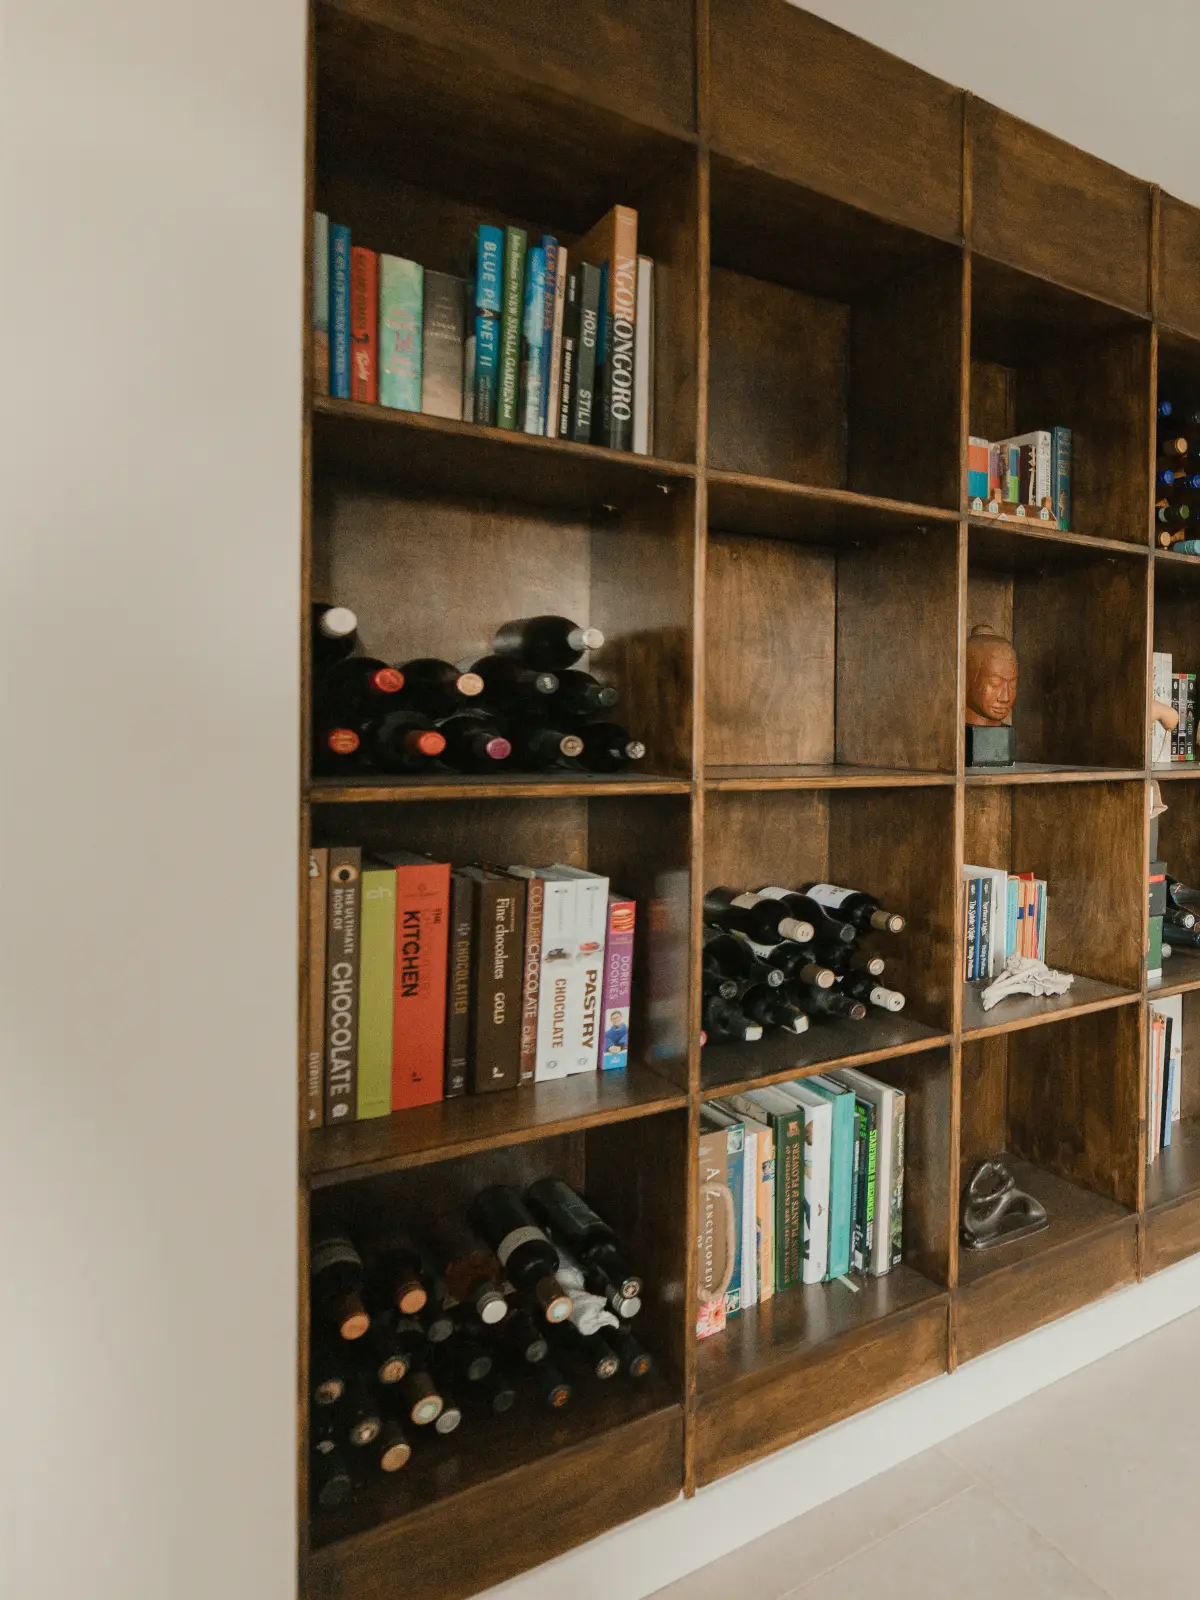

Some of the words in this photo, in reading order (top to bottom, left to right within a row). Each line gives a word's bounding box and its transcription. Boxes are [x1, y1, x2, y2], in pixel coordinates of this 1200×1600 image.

[483, 240, 498, 282] BLUE
[478, 288, 495, 352] PLANET
[506, 292, 518, 317] NEW
[504, 316, 518, 357] SMALL
[565, 338, 573, 351] THE
[582, 309, 597, 347] HOLD
[610, 254, 635, 421] NGORONGORO
[479, 355, 493, 367] II
[502, 357, 517, 404] GARDEN
[563, 351, 572, 382] COMPLETE
[562, 383, 570, 404] GUIDE
[577, 388, 592, 428] STILL
[333, 887, 344, 916] BOOK
[344, 887, 355, 906] THE
[496, 897, 511, 922] Fine
[530, 886, 542, 945] COUTURE
[332, 917, 342, 931] OF
[343, 907, 355, 954] ULTIMATE
[400, 910, 421, 998] KITCHEN
[493, 923, 510, 980] chocolates
[453, 939, 470, 1016] CHOCOLATIER
[525, 944, 541, 1018] CHOCOLATE
[608, 953, 621, 1000] COOKIES
[619, 955, 631, 996] DORIE'S
[329, 961, 354, 1097] CHOCOLATE
[494, 992, 506, 1024] GOLD
[551, 977, 567, 1048] CHOCOLATE
[581, 969, 598, 1049] PASTRY
[706, 1167, 720, 1181] A
[791, 1142, 800, 1189] FLOWERS
[704, 1203, 714, 1289] ENCYCLOPEDI
